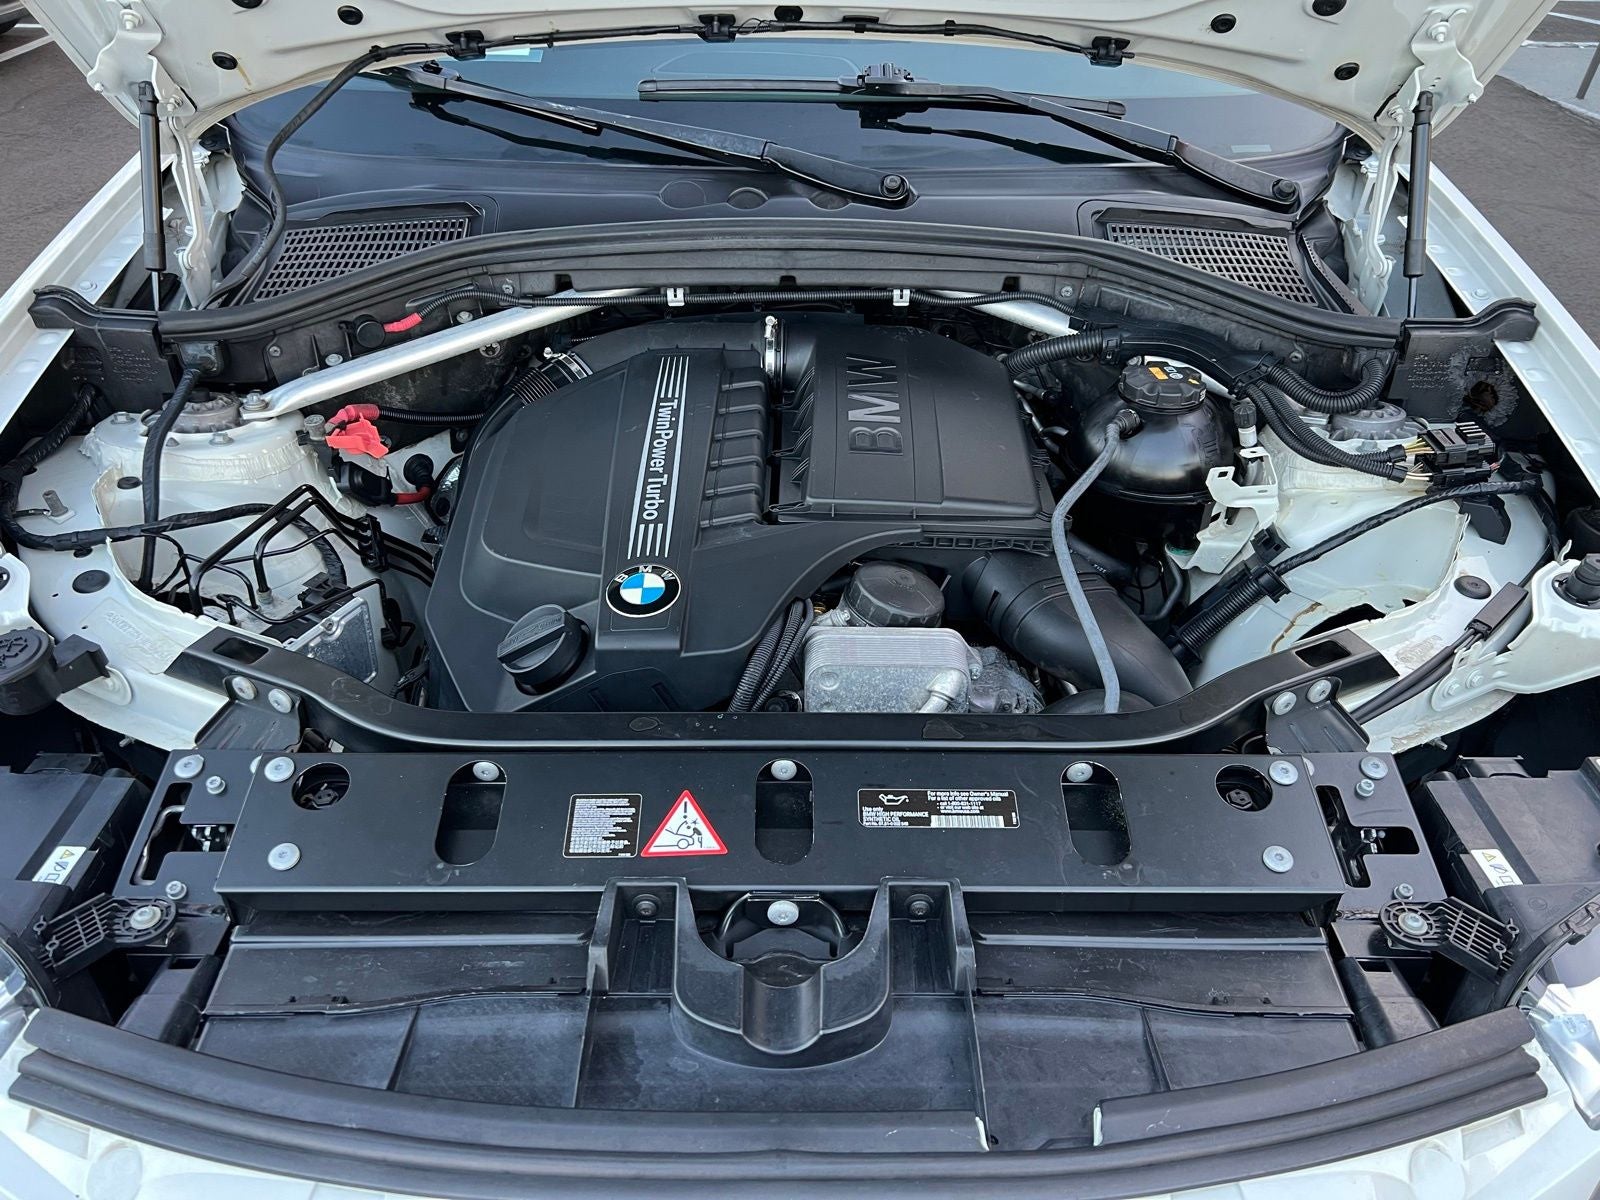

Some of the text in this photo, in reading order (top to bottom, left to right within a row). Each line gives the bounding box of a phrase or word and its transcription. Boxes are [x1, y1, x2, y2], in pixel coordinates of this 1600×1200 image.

[846, 355, 904, 455] BMW
[642, 399, 678, 520] TwinPower Turbo
[614, 564, 676, 583] BMW
